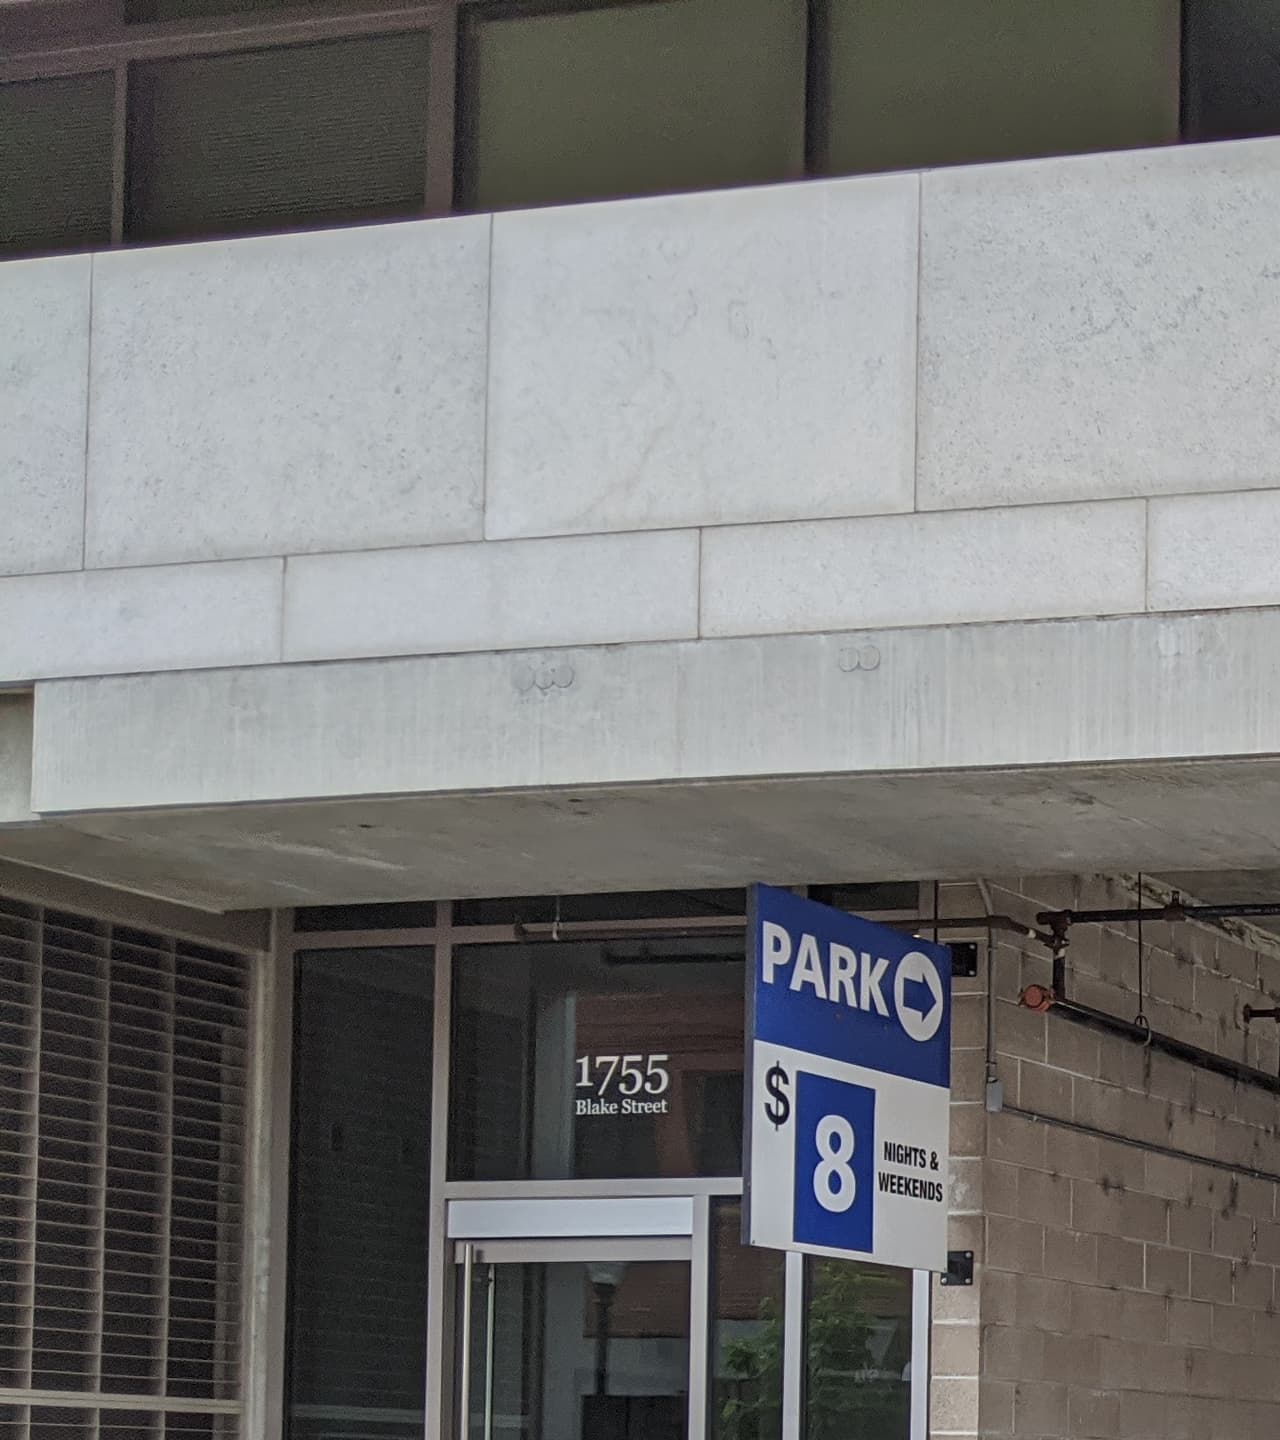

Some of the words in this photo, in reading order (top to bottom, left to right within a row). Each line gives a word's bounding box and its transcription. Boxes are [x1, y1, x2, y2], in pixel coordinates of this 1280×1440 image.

[762, 920, 890, 1018] PARK
[575, 1054, 669, 1096] 1755
[575, 1098, 618, 1115] Blake
[621, 1098, 668, 1114] Street
[764, 1060, 790, 1131] $
[813, 1114, 857, 1213] 8
[883, 1141, 927, 1170] NIGHTS
[929, 1151, 939, 1171] &
[878, 1171, 944, 1202] WEEKENDS
